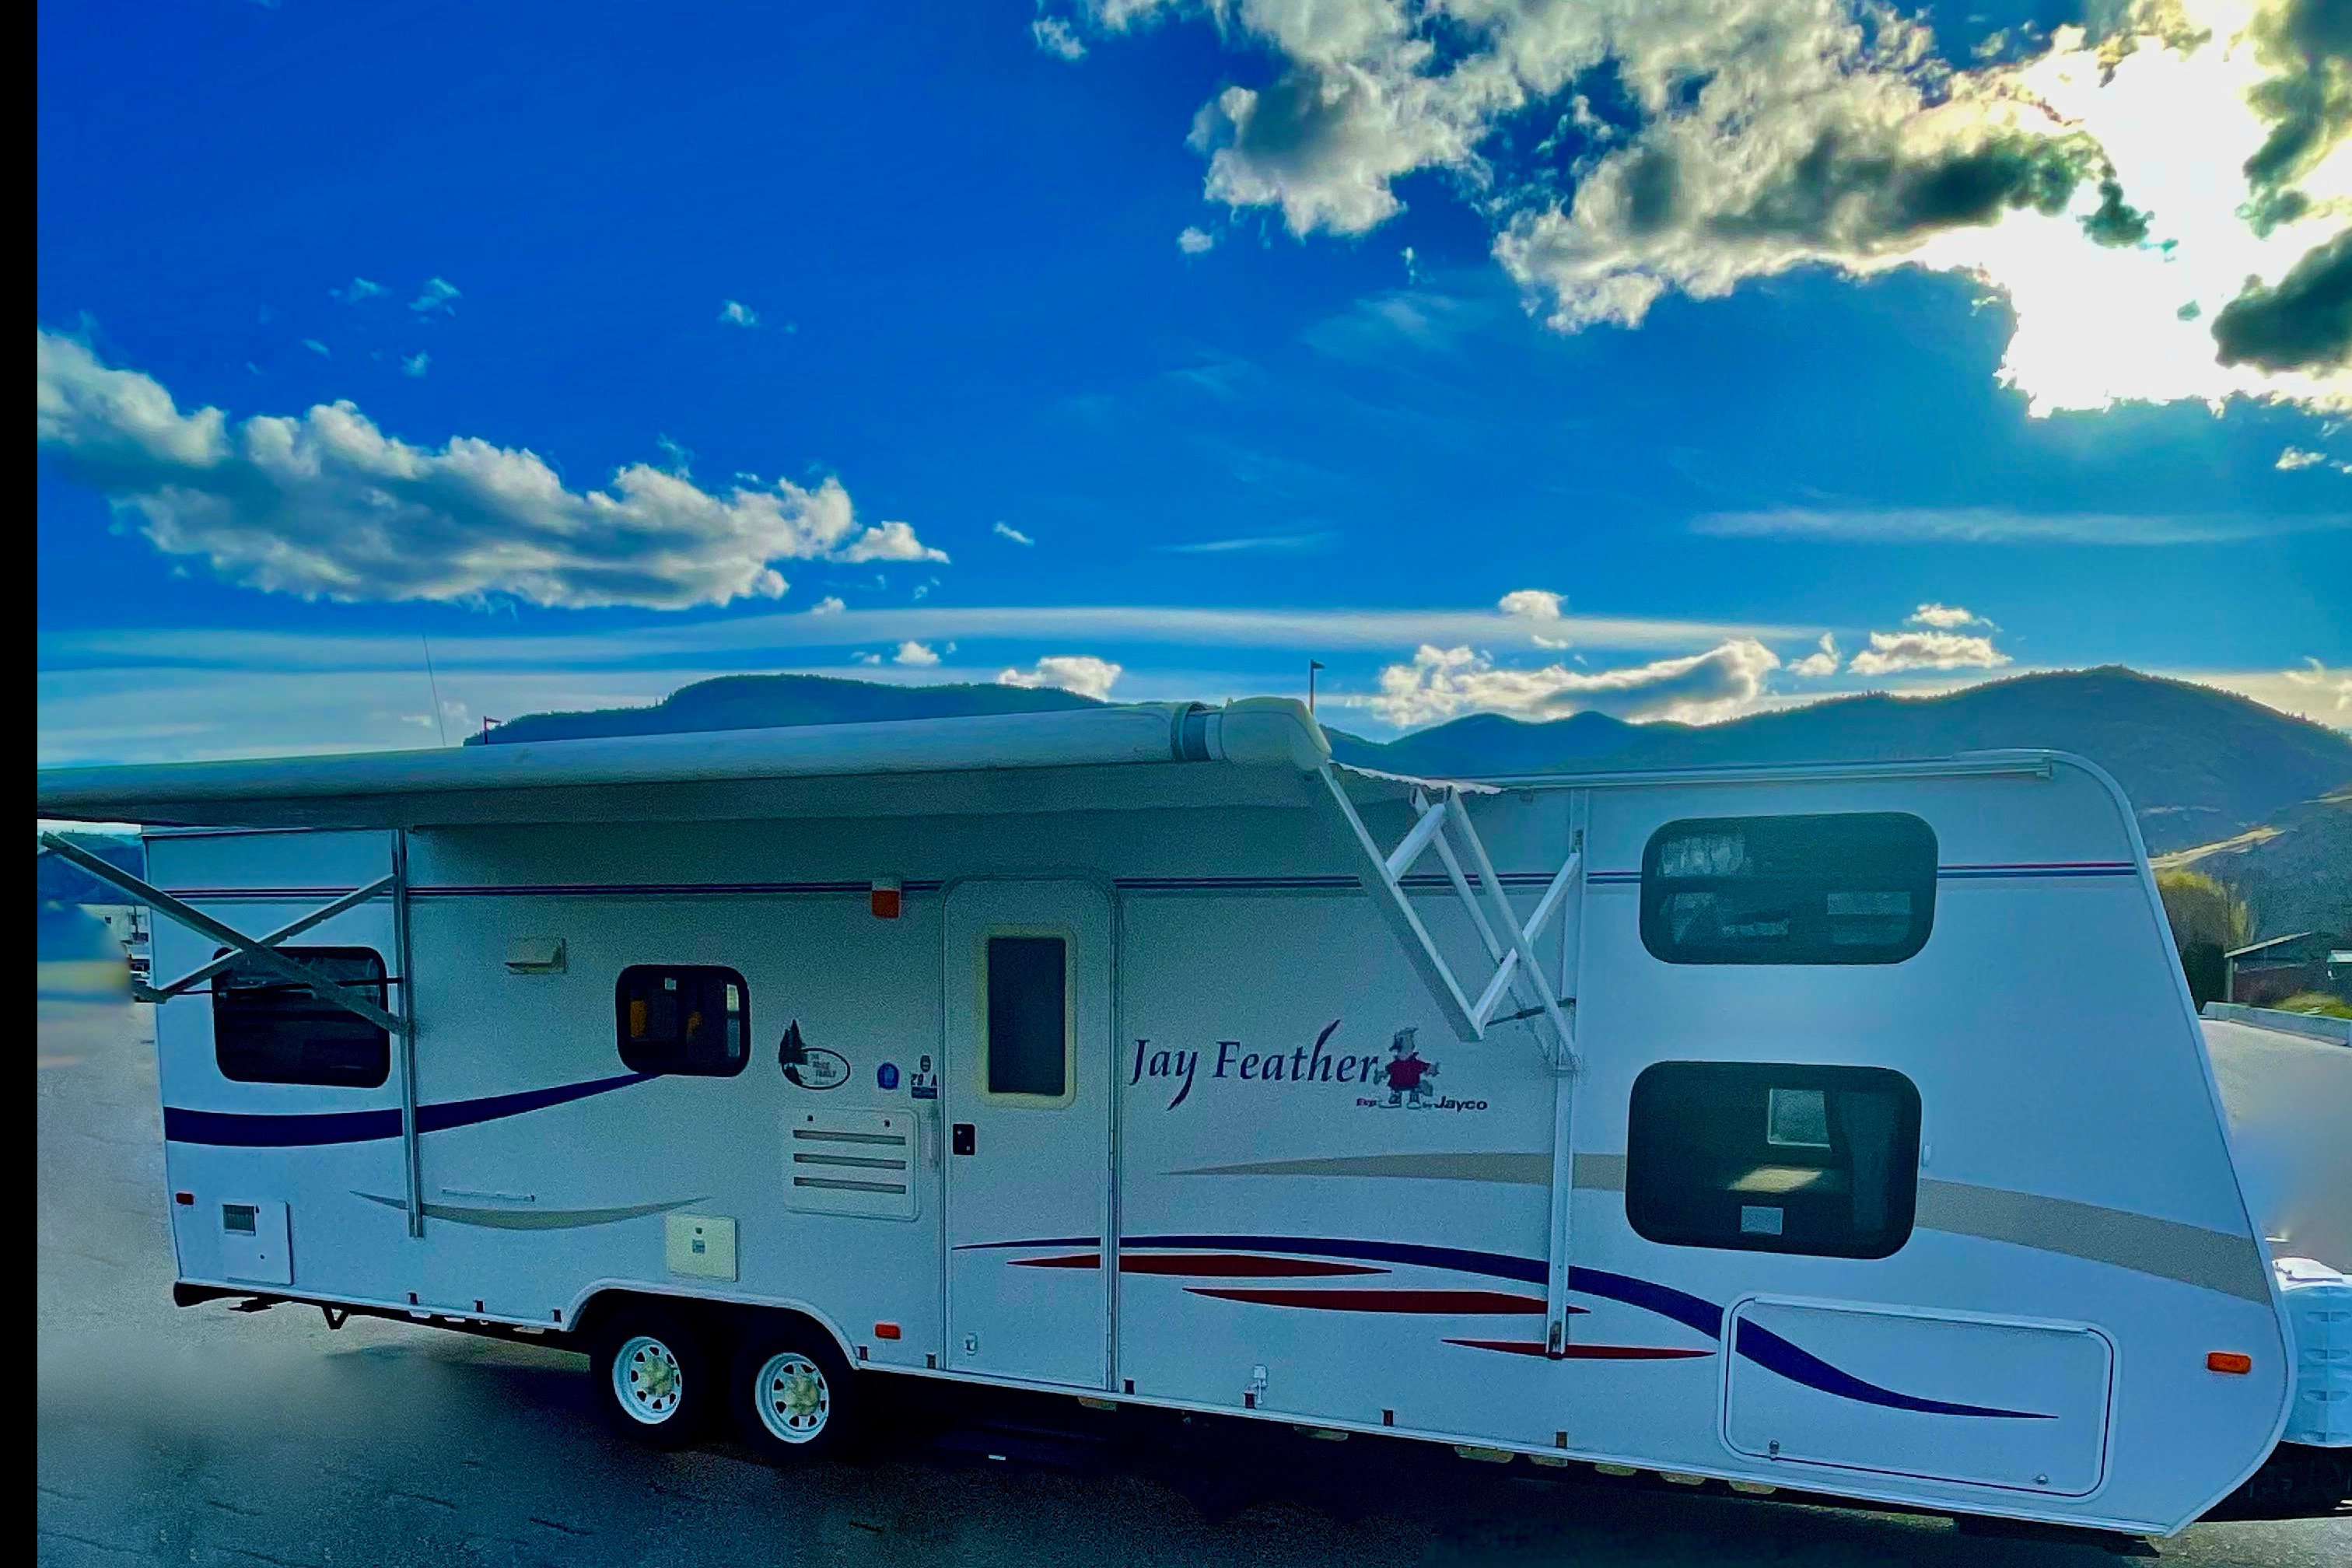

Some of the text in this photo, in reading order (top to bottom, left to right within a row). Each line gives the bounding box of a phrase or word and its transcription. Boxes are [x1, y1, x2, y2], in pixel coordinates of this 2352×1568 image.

[1128, 1019, 1379, 1111] Jay Feather
[1434, 1095, 1488, 1112] Jayco
